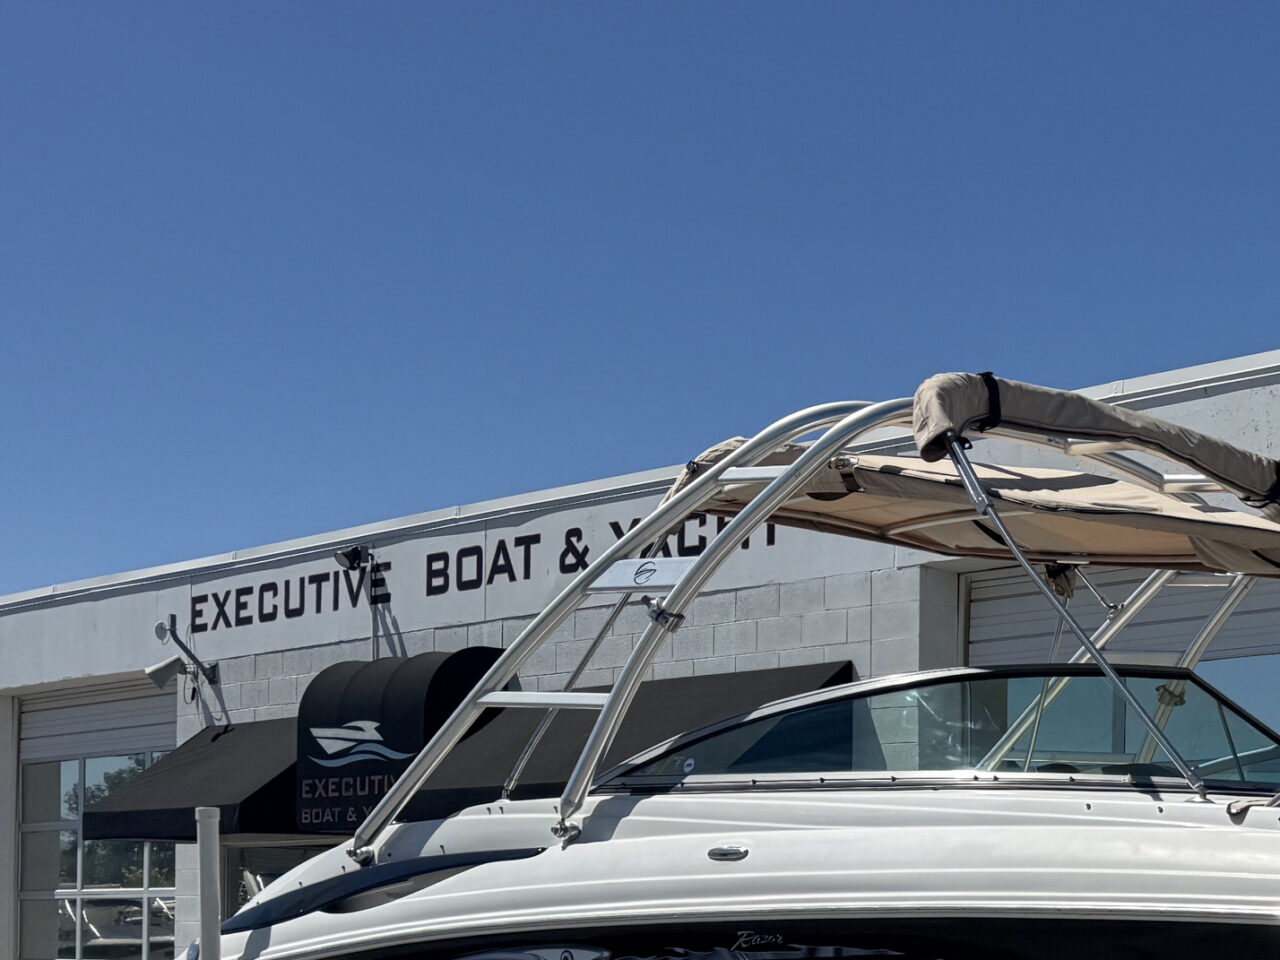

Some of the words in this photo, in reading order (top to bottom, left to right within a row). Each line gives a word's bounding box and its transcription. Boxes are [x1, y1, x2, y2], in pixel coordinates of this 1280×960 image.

[190, 561, 392, 634] EXECUTIVE
[425, 532, 541, 597] BOAT
[558, 527, 591, 575] &
[301, 774, 396, 799] EXECUTI
[301, 807, 341, 824] BOAT
[346, 806, 357, 822] &
